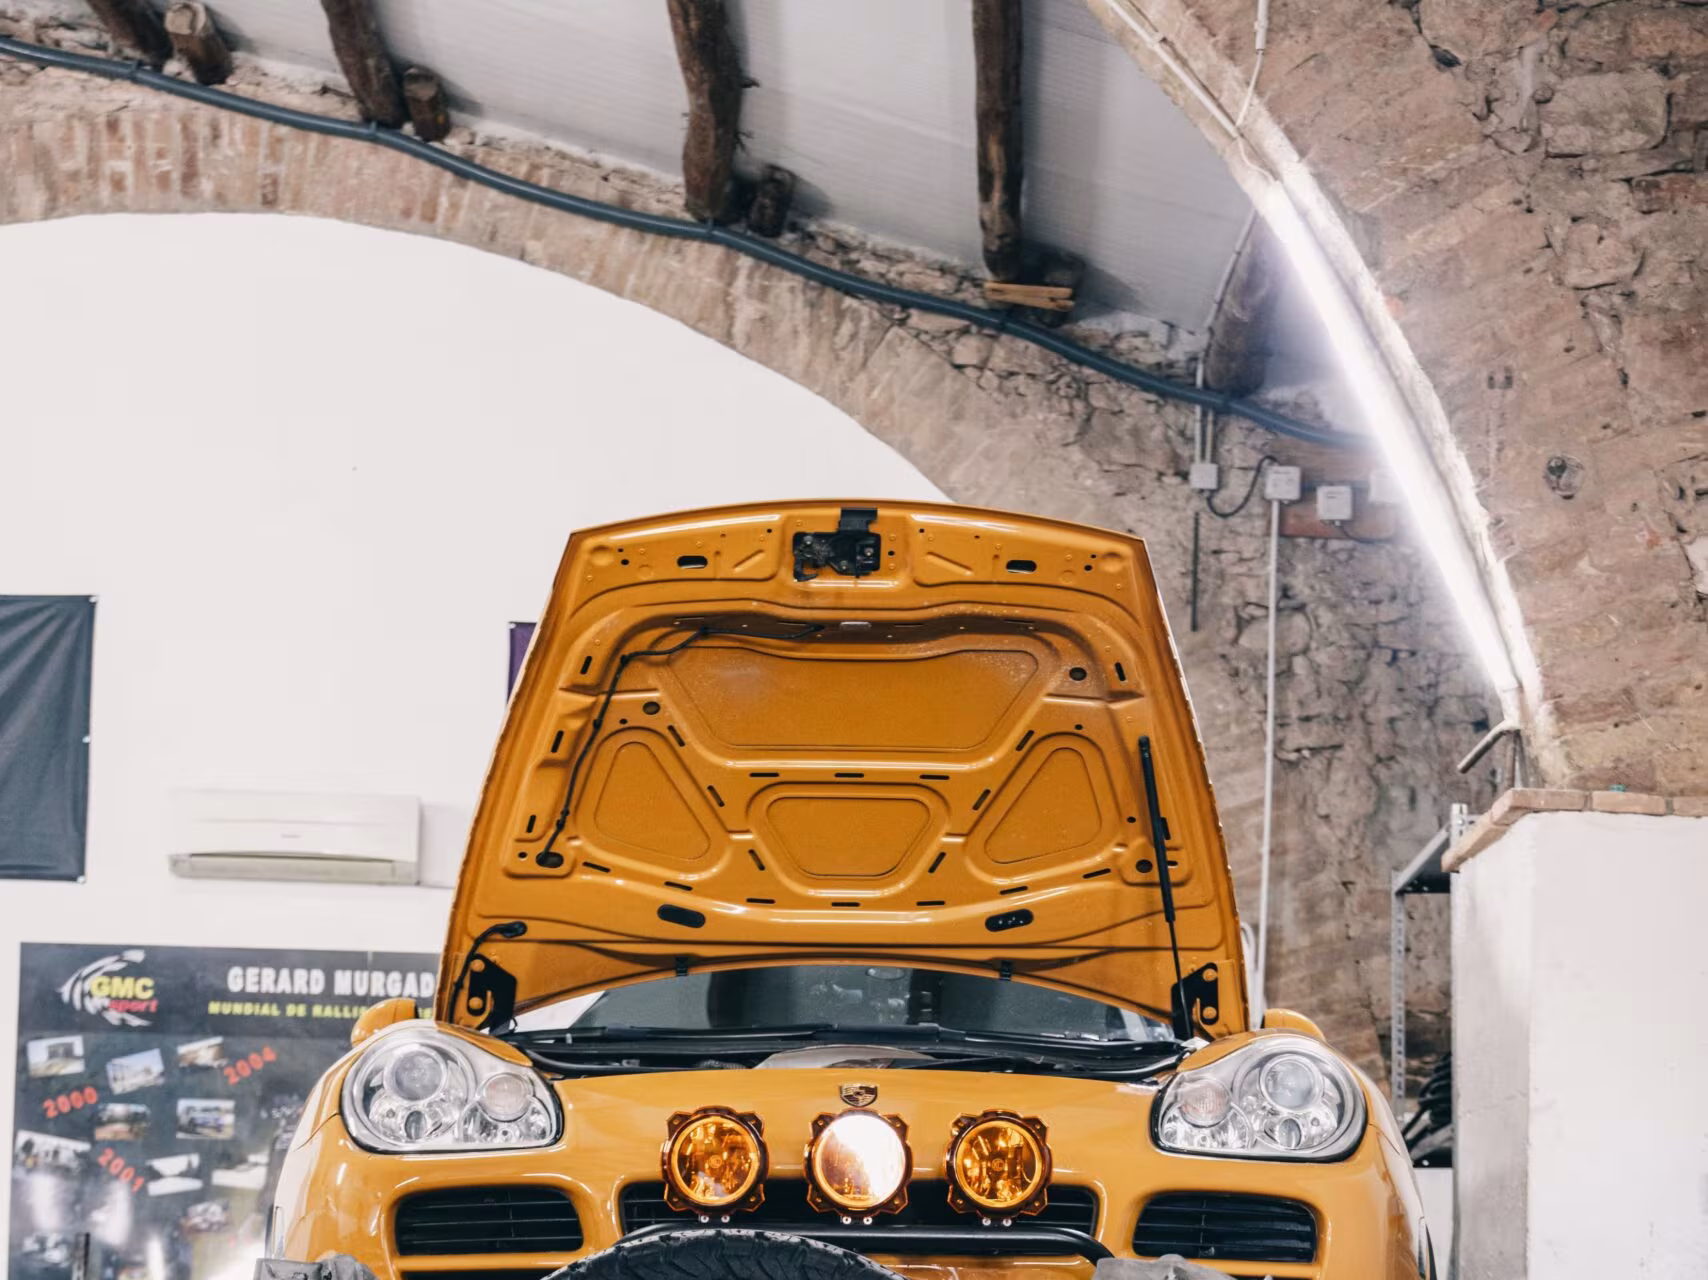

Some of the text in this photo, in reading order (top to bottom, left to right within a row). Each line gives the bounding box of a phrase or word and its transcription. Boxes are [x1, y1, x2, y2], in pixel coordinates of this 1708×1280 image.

[91, 976, 154, 999] GMC
[227, 966, 325, 995] GERARD
[208, 1001, 280, 1017] MUNDIAL
[286, 1003, 307, 1018] DE
[224, 1044, 277, 1086] 2004
[43, 1086, 99, 1119] 2000
[97, 1147, 145, 1194] 2001
